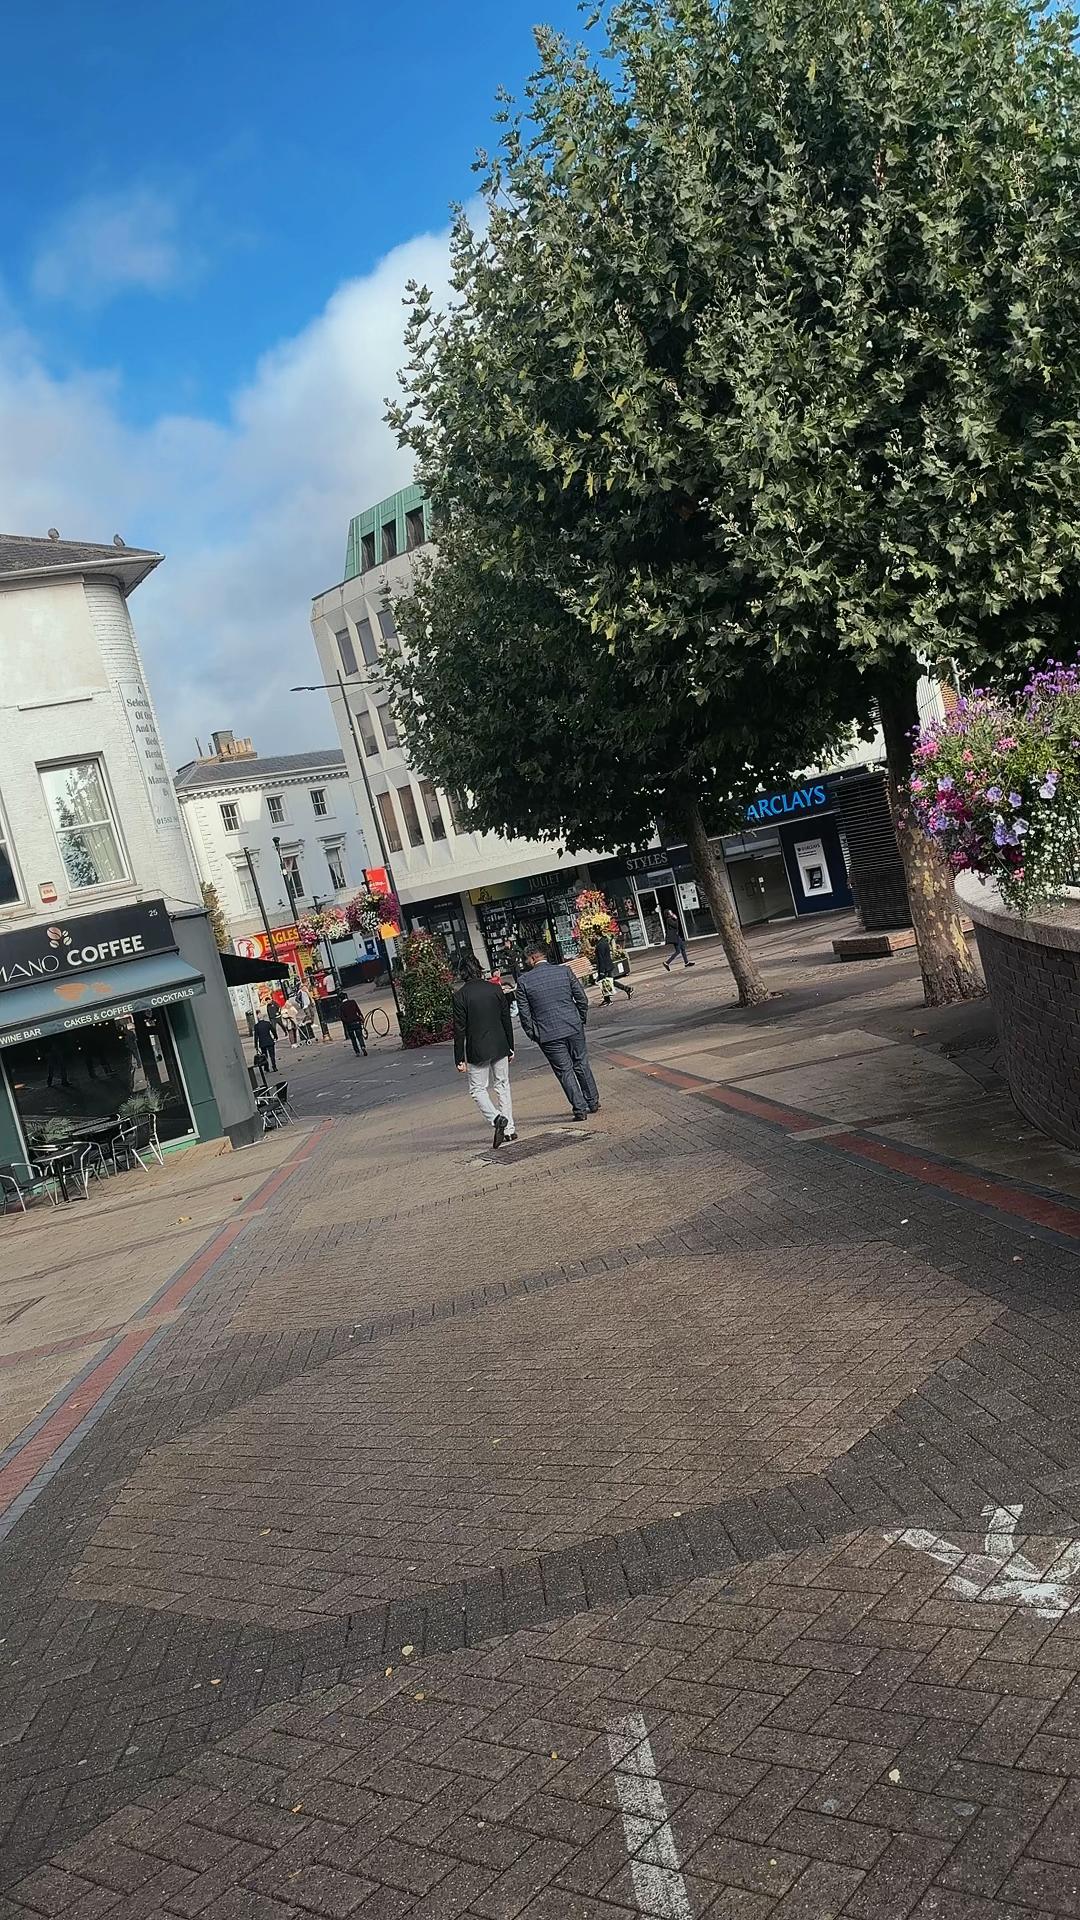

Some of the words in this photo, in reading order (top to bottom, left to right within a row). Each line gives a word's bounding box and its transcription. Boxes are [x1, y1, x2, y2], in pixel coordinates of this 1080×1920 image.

[744, 785, 826, 822] ARCLAYS
[626, 852, 668, 870] STYLES
[528, 872, 560, 892] JULIET
[148, 909, 159, 917] 25
[66, 935, 145, 966] COFFEE
[151, 988, 194, 1006] COCKTAILS
[63, 1015, 92, 1028] CAKES
[93, 1012, 100, 1021] &
[100, 1004, 134, 1019] COFFEE
[0, 1033, 23, 1045] WINE
[23, 1028, 42, 1039] BAR
